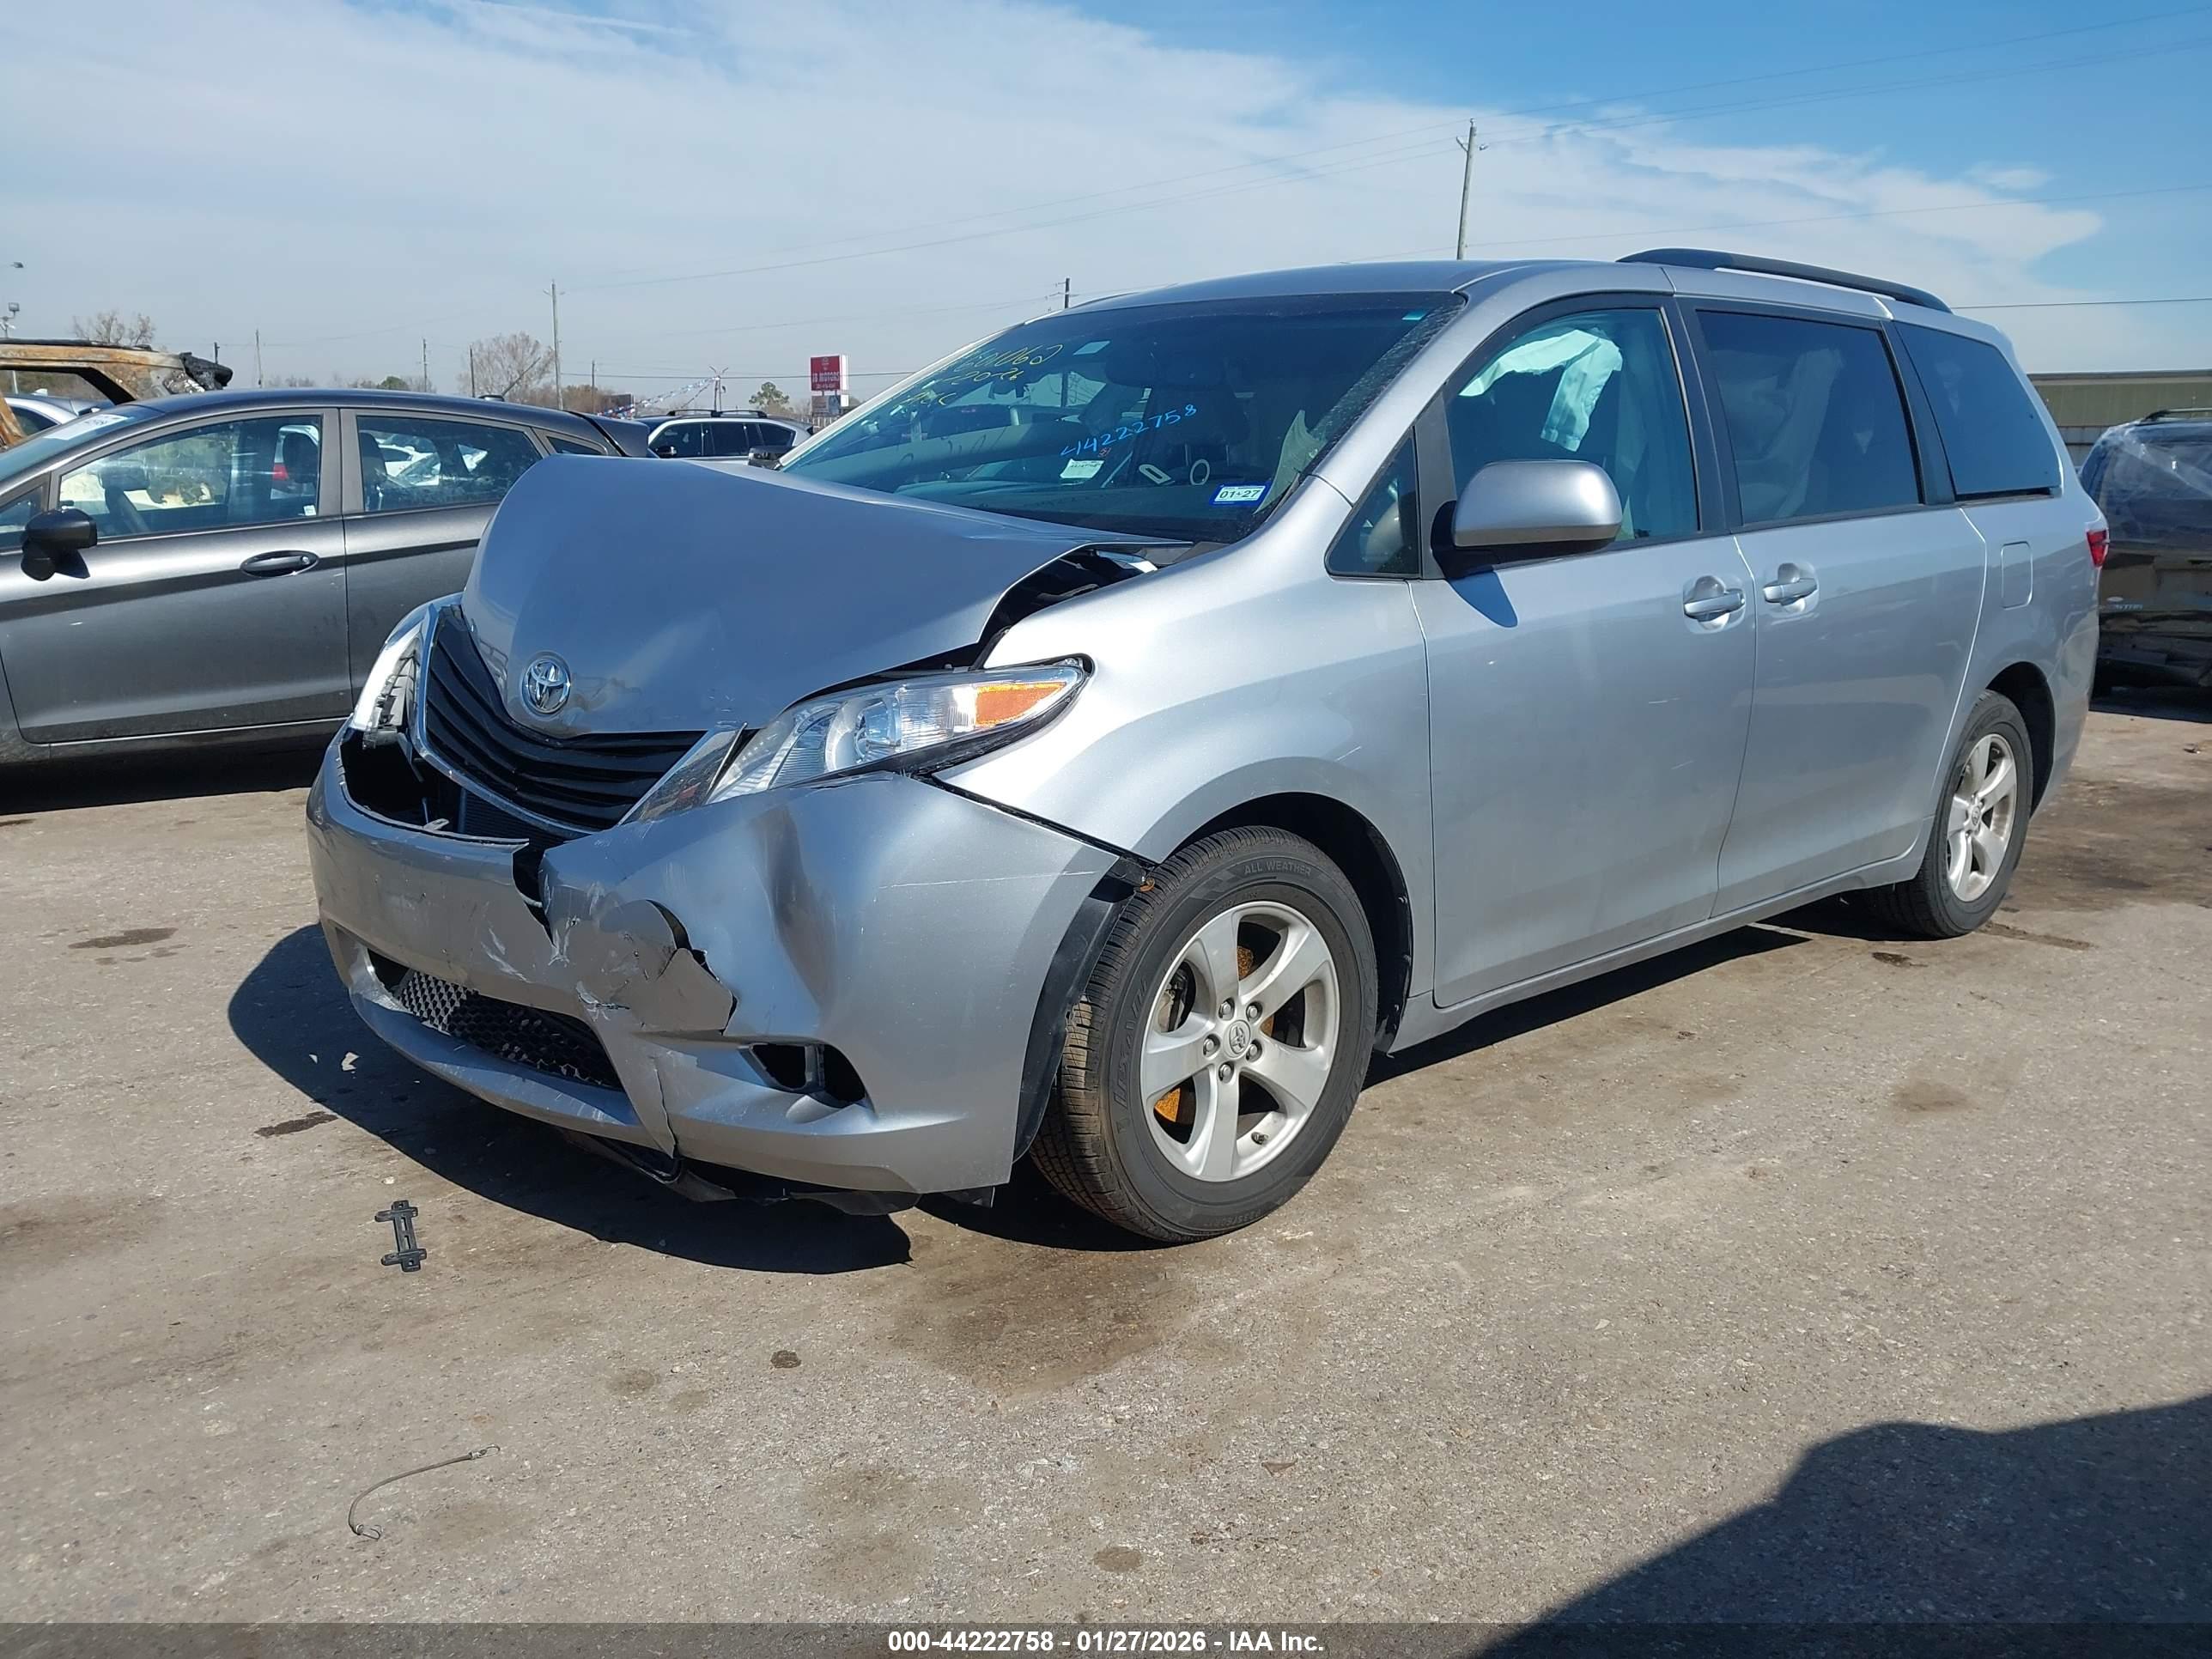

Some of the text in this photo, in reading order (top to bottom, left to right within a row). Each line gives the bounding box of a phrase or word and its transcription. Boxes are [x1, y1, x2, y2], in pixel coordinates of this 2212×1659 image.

[1059, 404, 1197, 456] 44222758
[1243, 860, 1312, 877] ALL WEATHER
